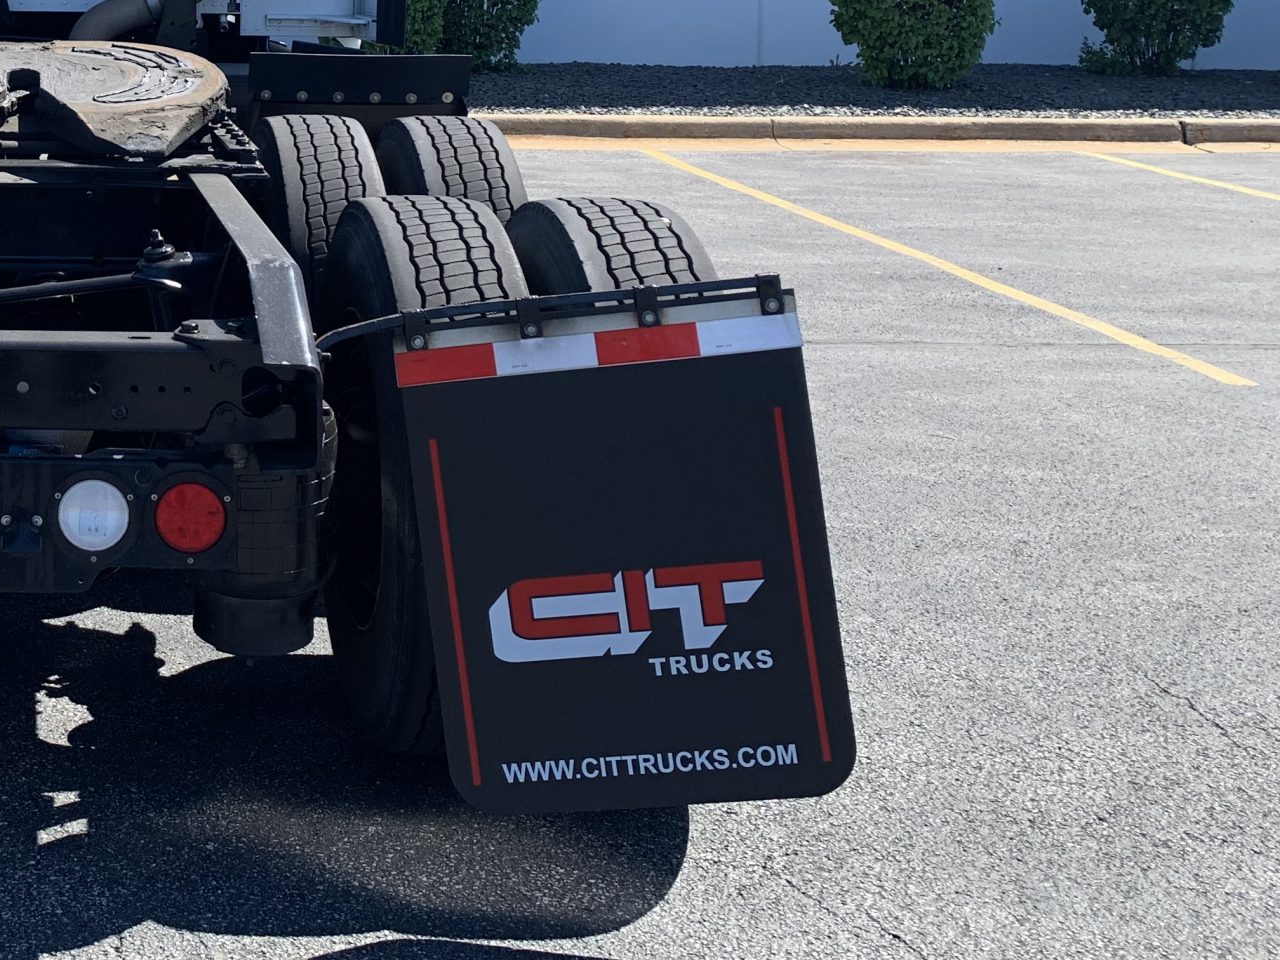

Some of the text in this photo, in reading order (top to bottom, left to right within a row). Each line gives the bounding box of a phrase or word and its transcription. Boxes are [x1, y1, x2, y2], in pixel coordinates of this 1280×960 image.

[488, 560, 765, 663] CIT
[648, 648, 774, 677] TRUCKS
[501, 743, 799, 784] WWW.CITTRUCKS.COM
